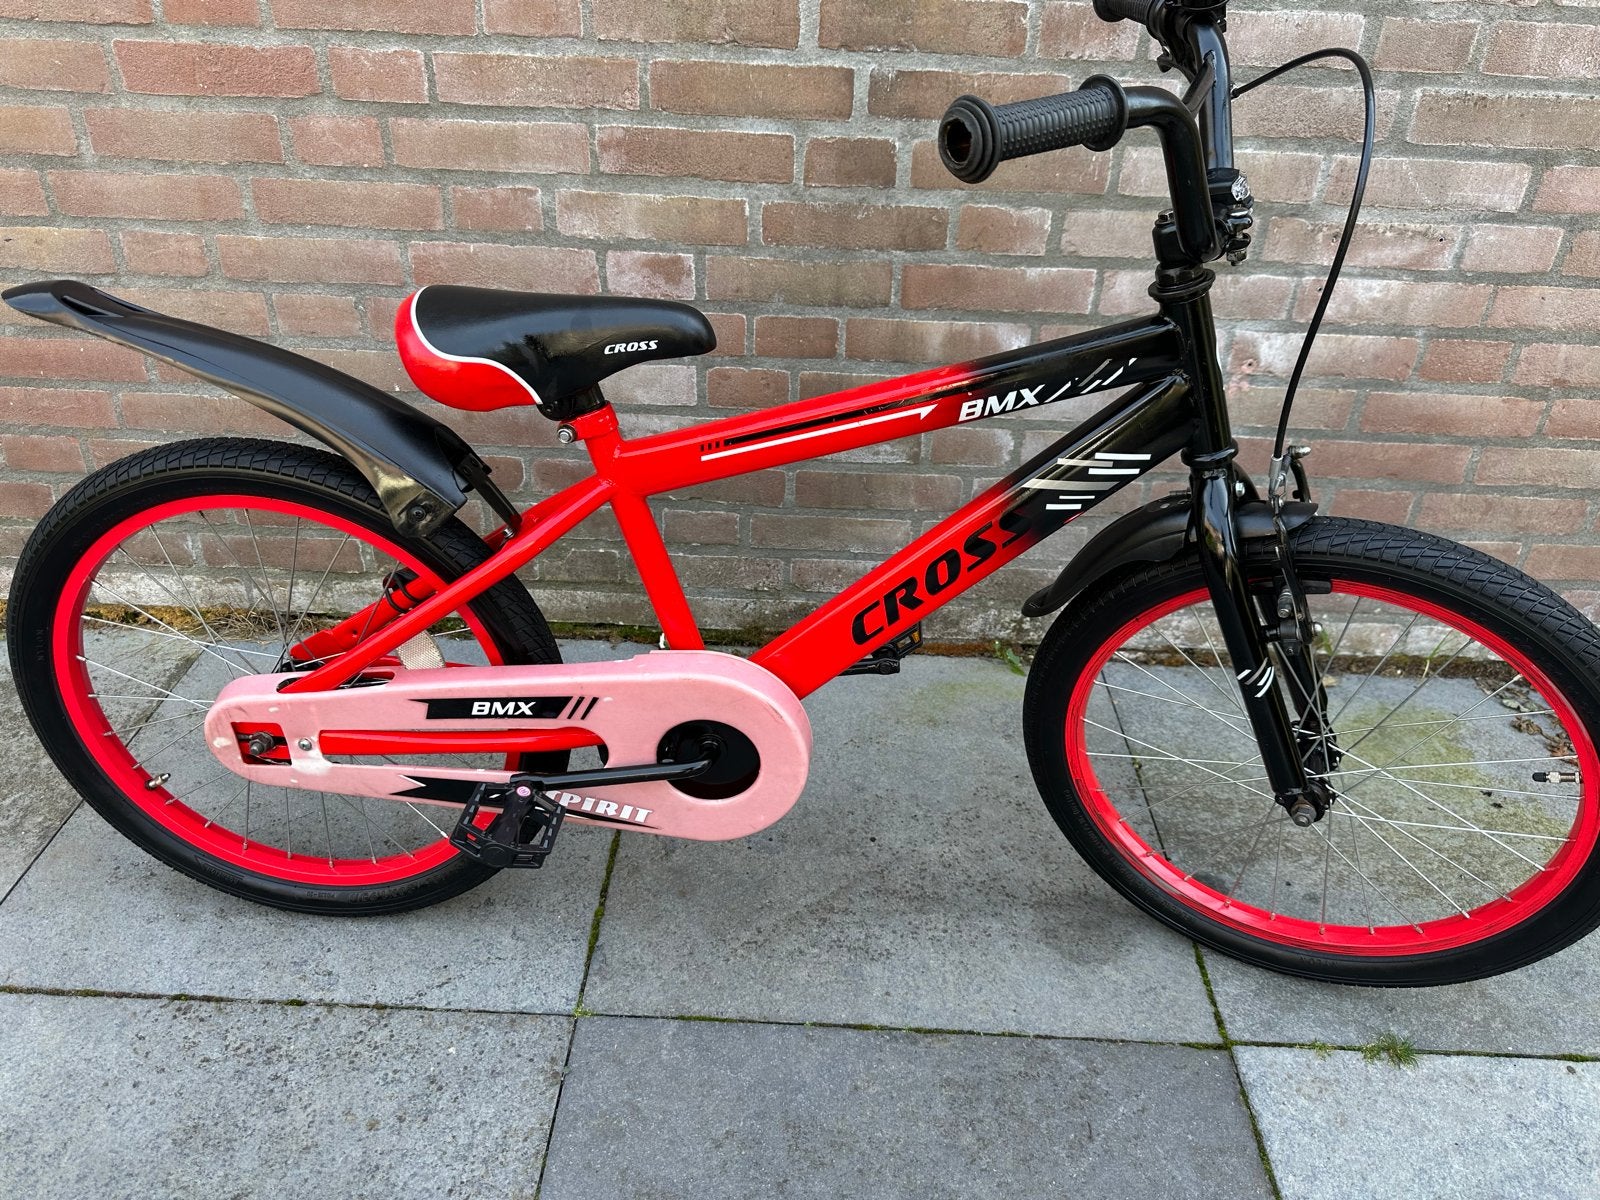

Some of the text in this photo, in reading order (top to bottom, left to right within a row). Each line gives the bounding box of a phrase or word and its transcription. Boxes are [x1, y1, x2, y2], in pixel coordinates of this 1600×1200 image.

[604, 340, 659, 355] CROSS
[958, 384, 1046, 422] BMX
[851, 503, 1033, 646] CROSS
[471, 701, 537, 716] BMX
